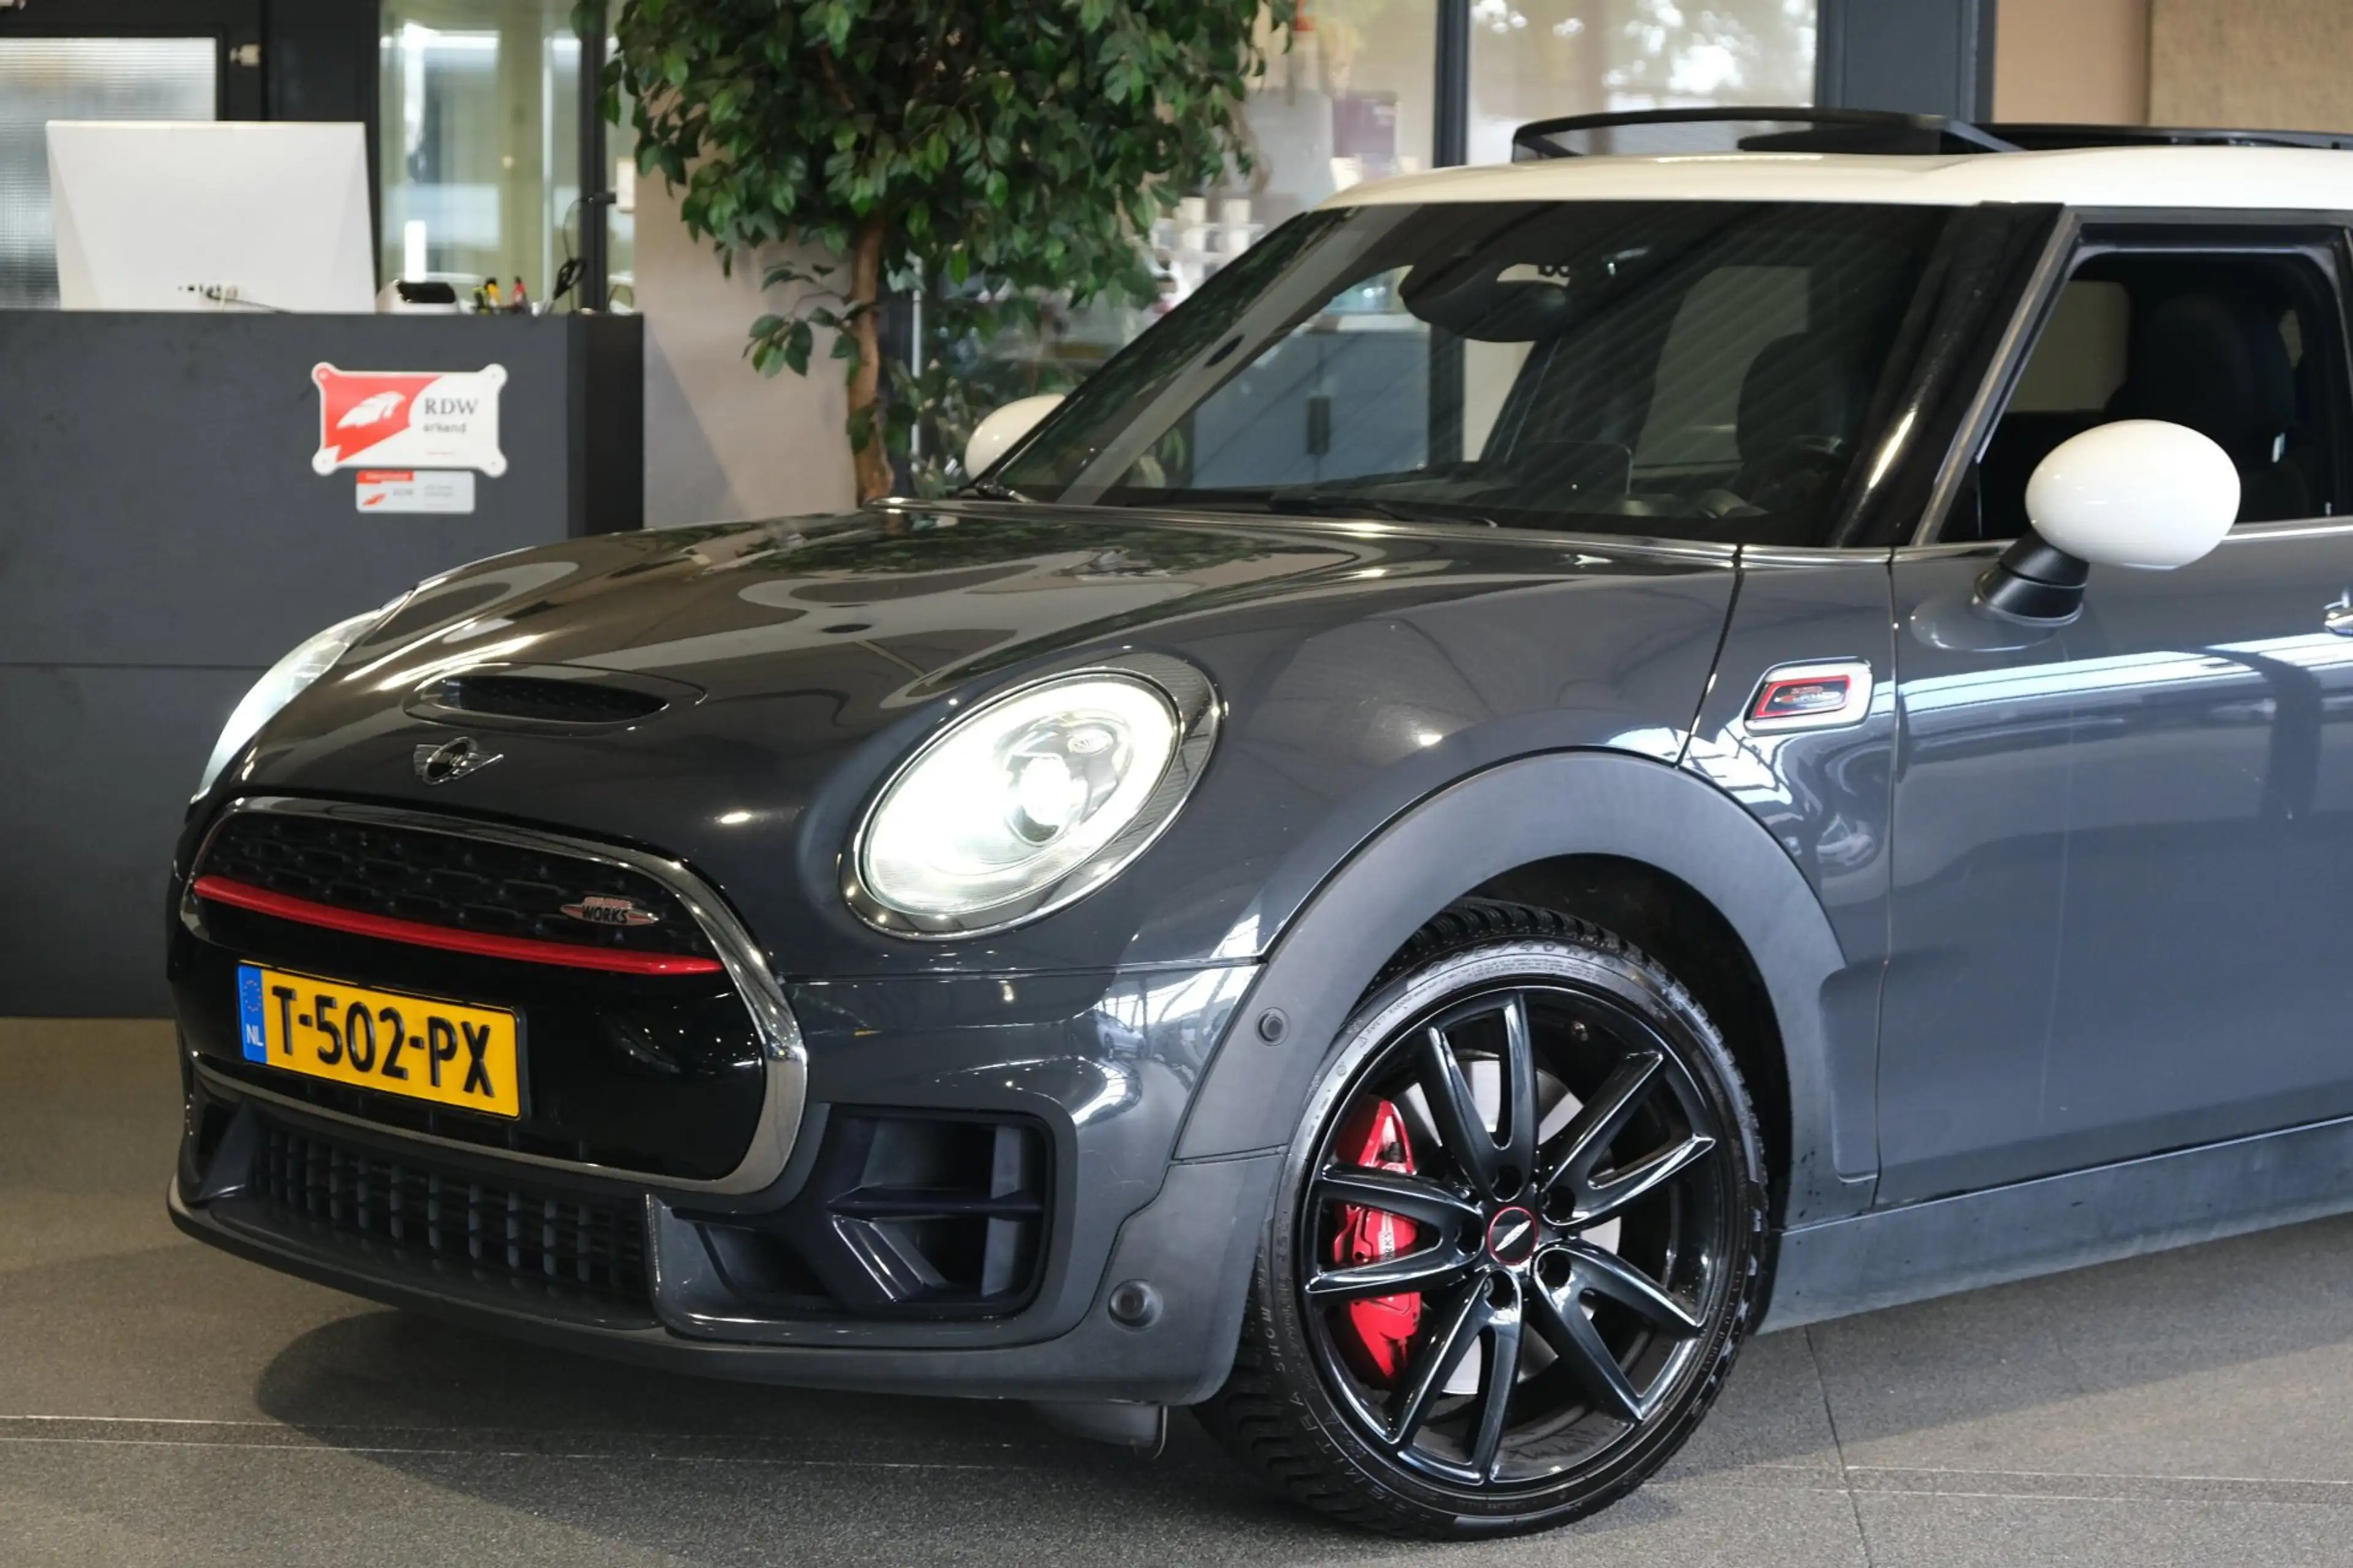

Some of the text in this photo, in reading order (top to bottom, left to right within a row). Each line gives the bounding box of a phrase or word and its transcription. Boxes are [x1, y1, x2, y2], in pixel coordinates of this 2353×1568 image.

[424, 397, 479, 415] RDW
[583, 904, 627, 924] WORKS
[244, 1023, 265, 1047] NL
[271, 985, 496, 1098] T-502-PX
